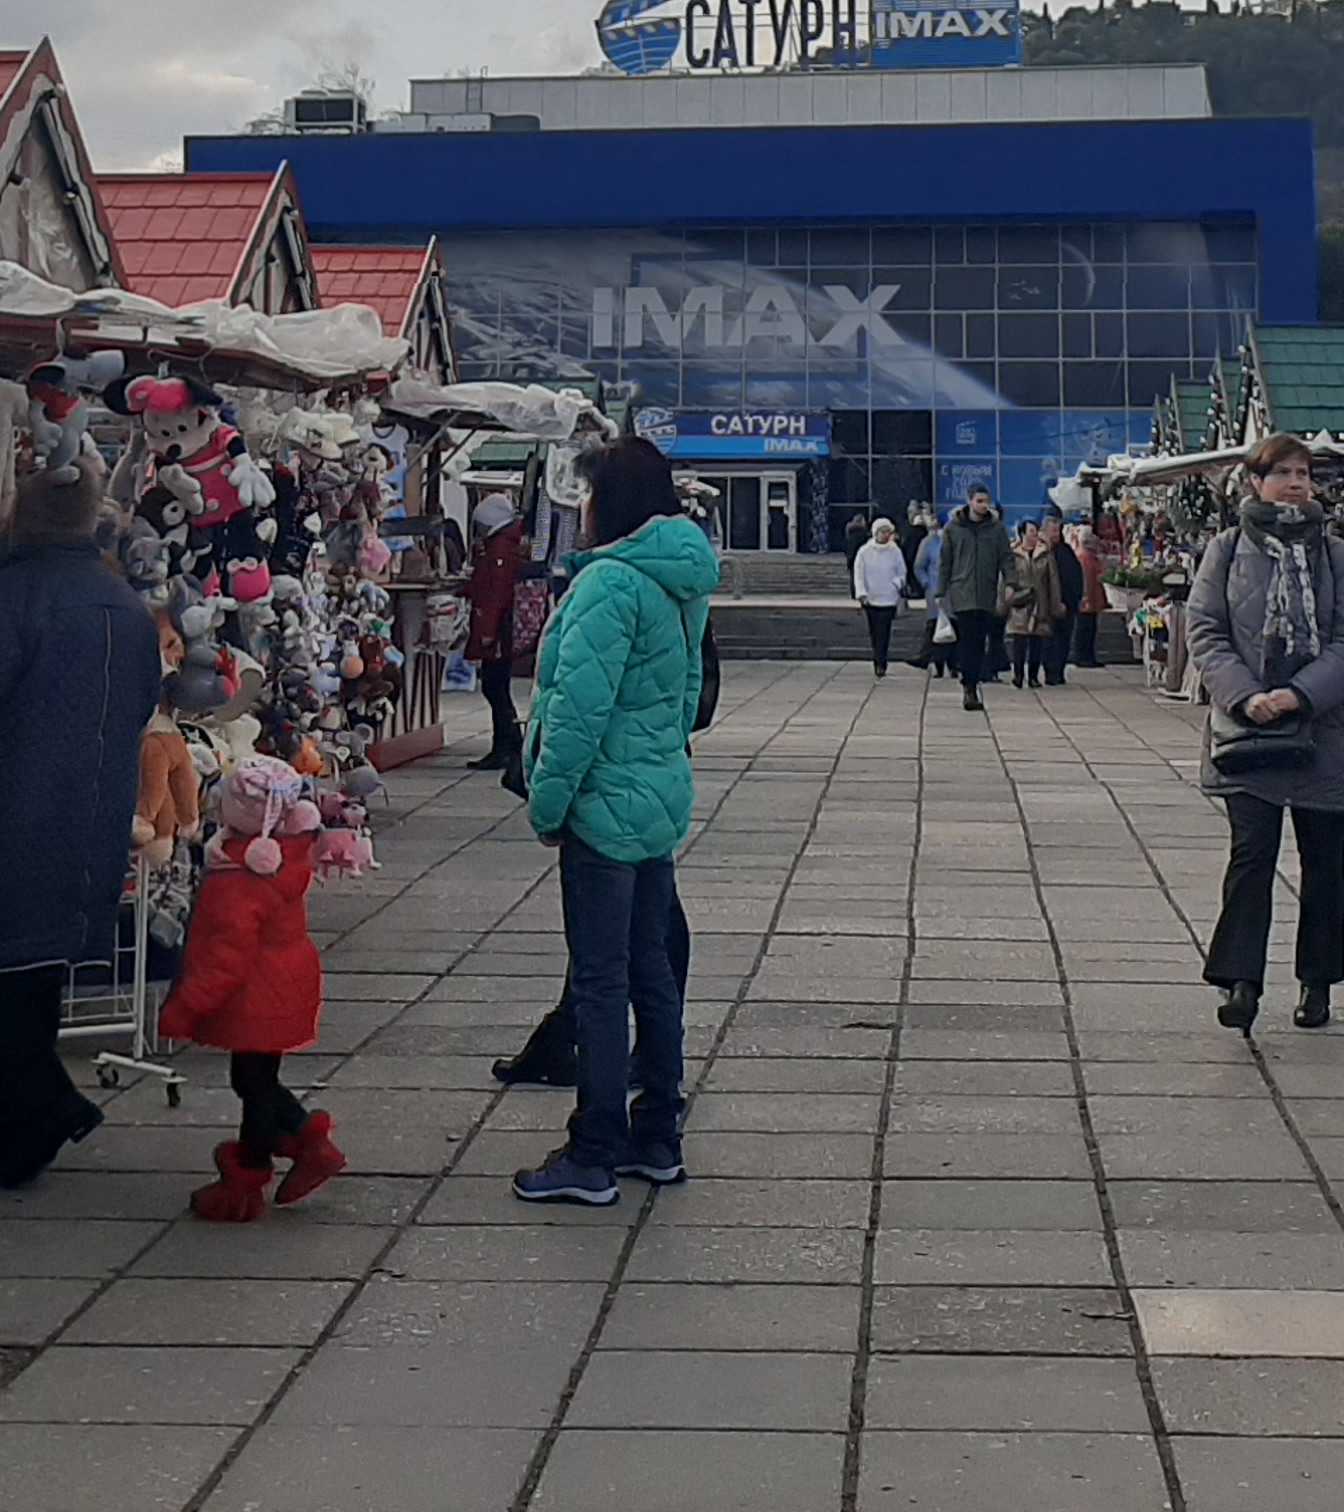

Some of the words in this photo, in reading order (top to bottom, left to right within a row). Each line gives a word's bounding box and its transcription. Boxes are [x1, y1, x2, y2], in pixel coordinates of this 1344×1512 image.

[874, 9, 1010, 39] IMAX
[592, 284, 907, 348] IMAX
[710, 414, 806, 435] САТУРН
[764, 438, 819, 452] IMAX
